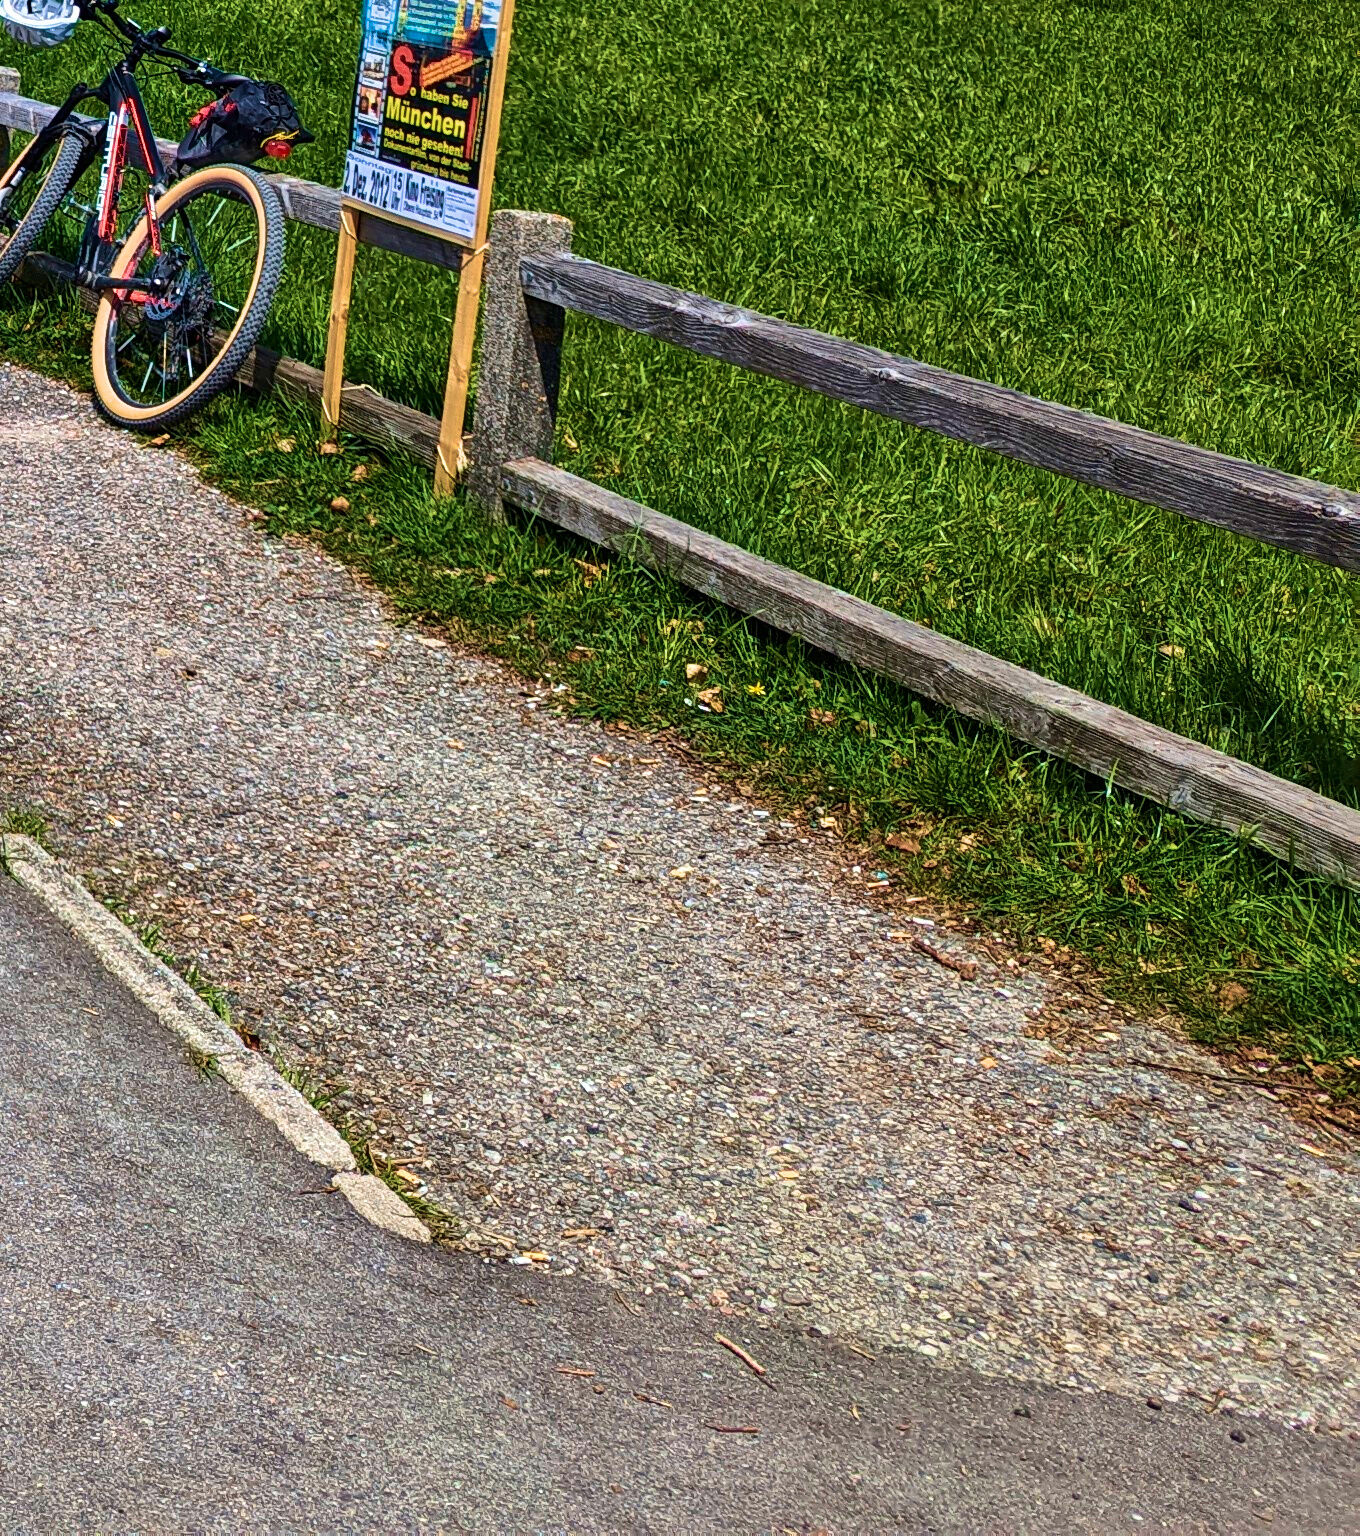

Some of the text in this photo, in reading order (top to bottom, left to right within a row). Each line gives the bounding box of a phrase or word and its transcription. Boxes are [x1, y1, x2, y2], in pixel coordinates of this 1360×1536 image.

[421, 87, 450, 105] haben
[452, 94, 469, 110] Sie
[385, 95, 466, 139] München
[384, 127, 465, 158] noch nie gesehen!
[347, 153, 392, 175] Sonntag
